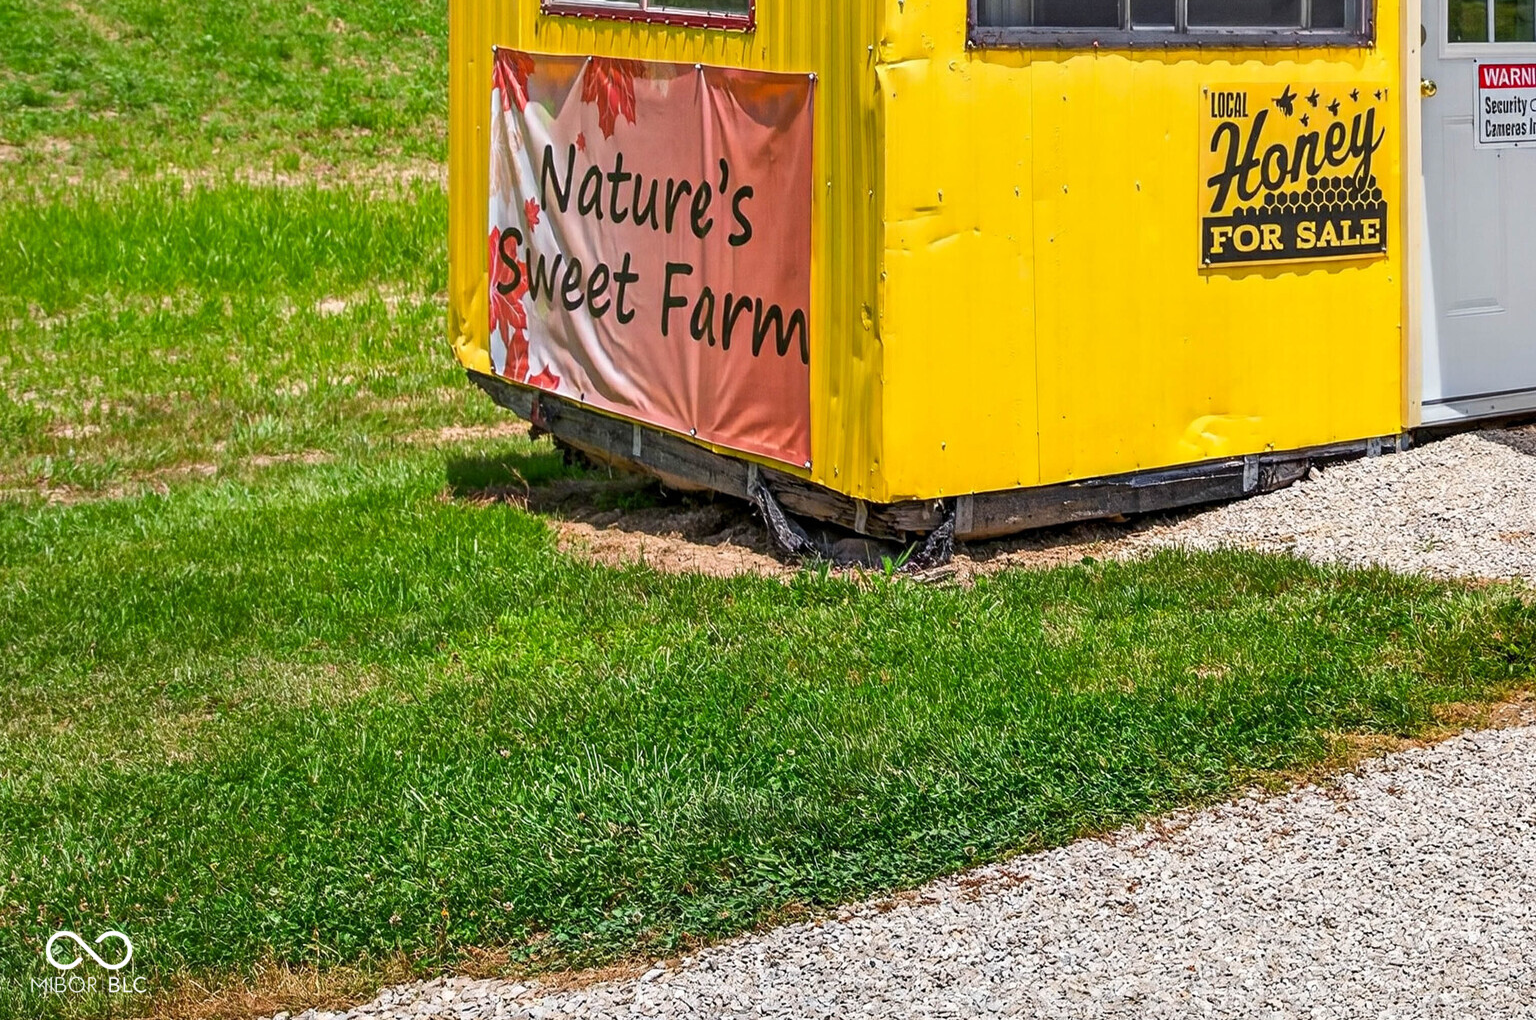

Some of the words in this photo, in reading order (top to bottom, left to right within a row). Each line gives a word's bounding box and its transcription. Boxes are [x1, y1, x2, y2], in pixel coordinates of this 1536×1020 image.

[1210, 92, 1248, 118] LOCAL
[1485, 95, 1528, 117] Security
[1485, 118, 1527, 138] Cameras
[1207, 107, 1385, 213] Honey
[540, 143, 754, 247] Nature's
[1210, 224, 1284, 254] FOR
[1296, 218, 1380, 250] SALE
[497, 227, 639, 325] Sweet
[660, 262, 809, 365] Farm
